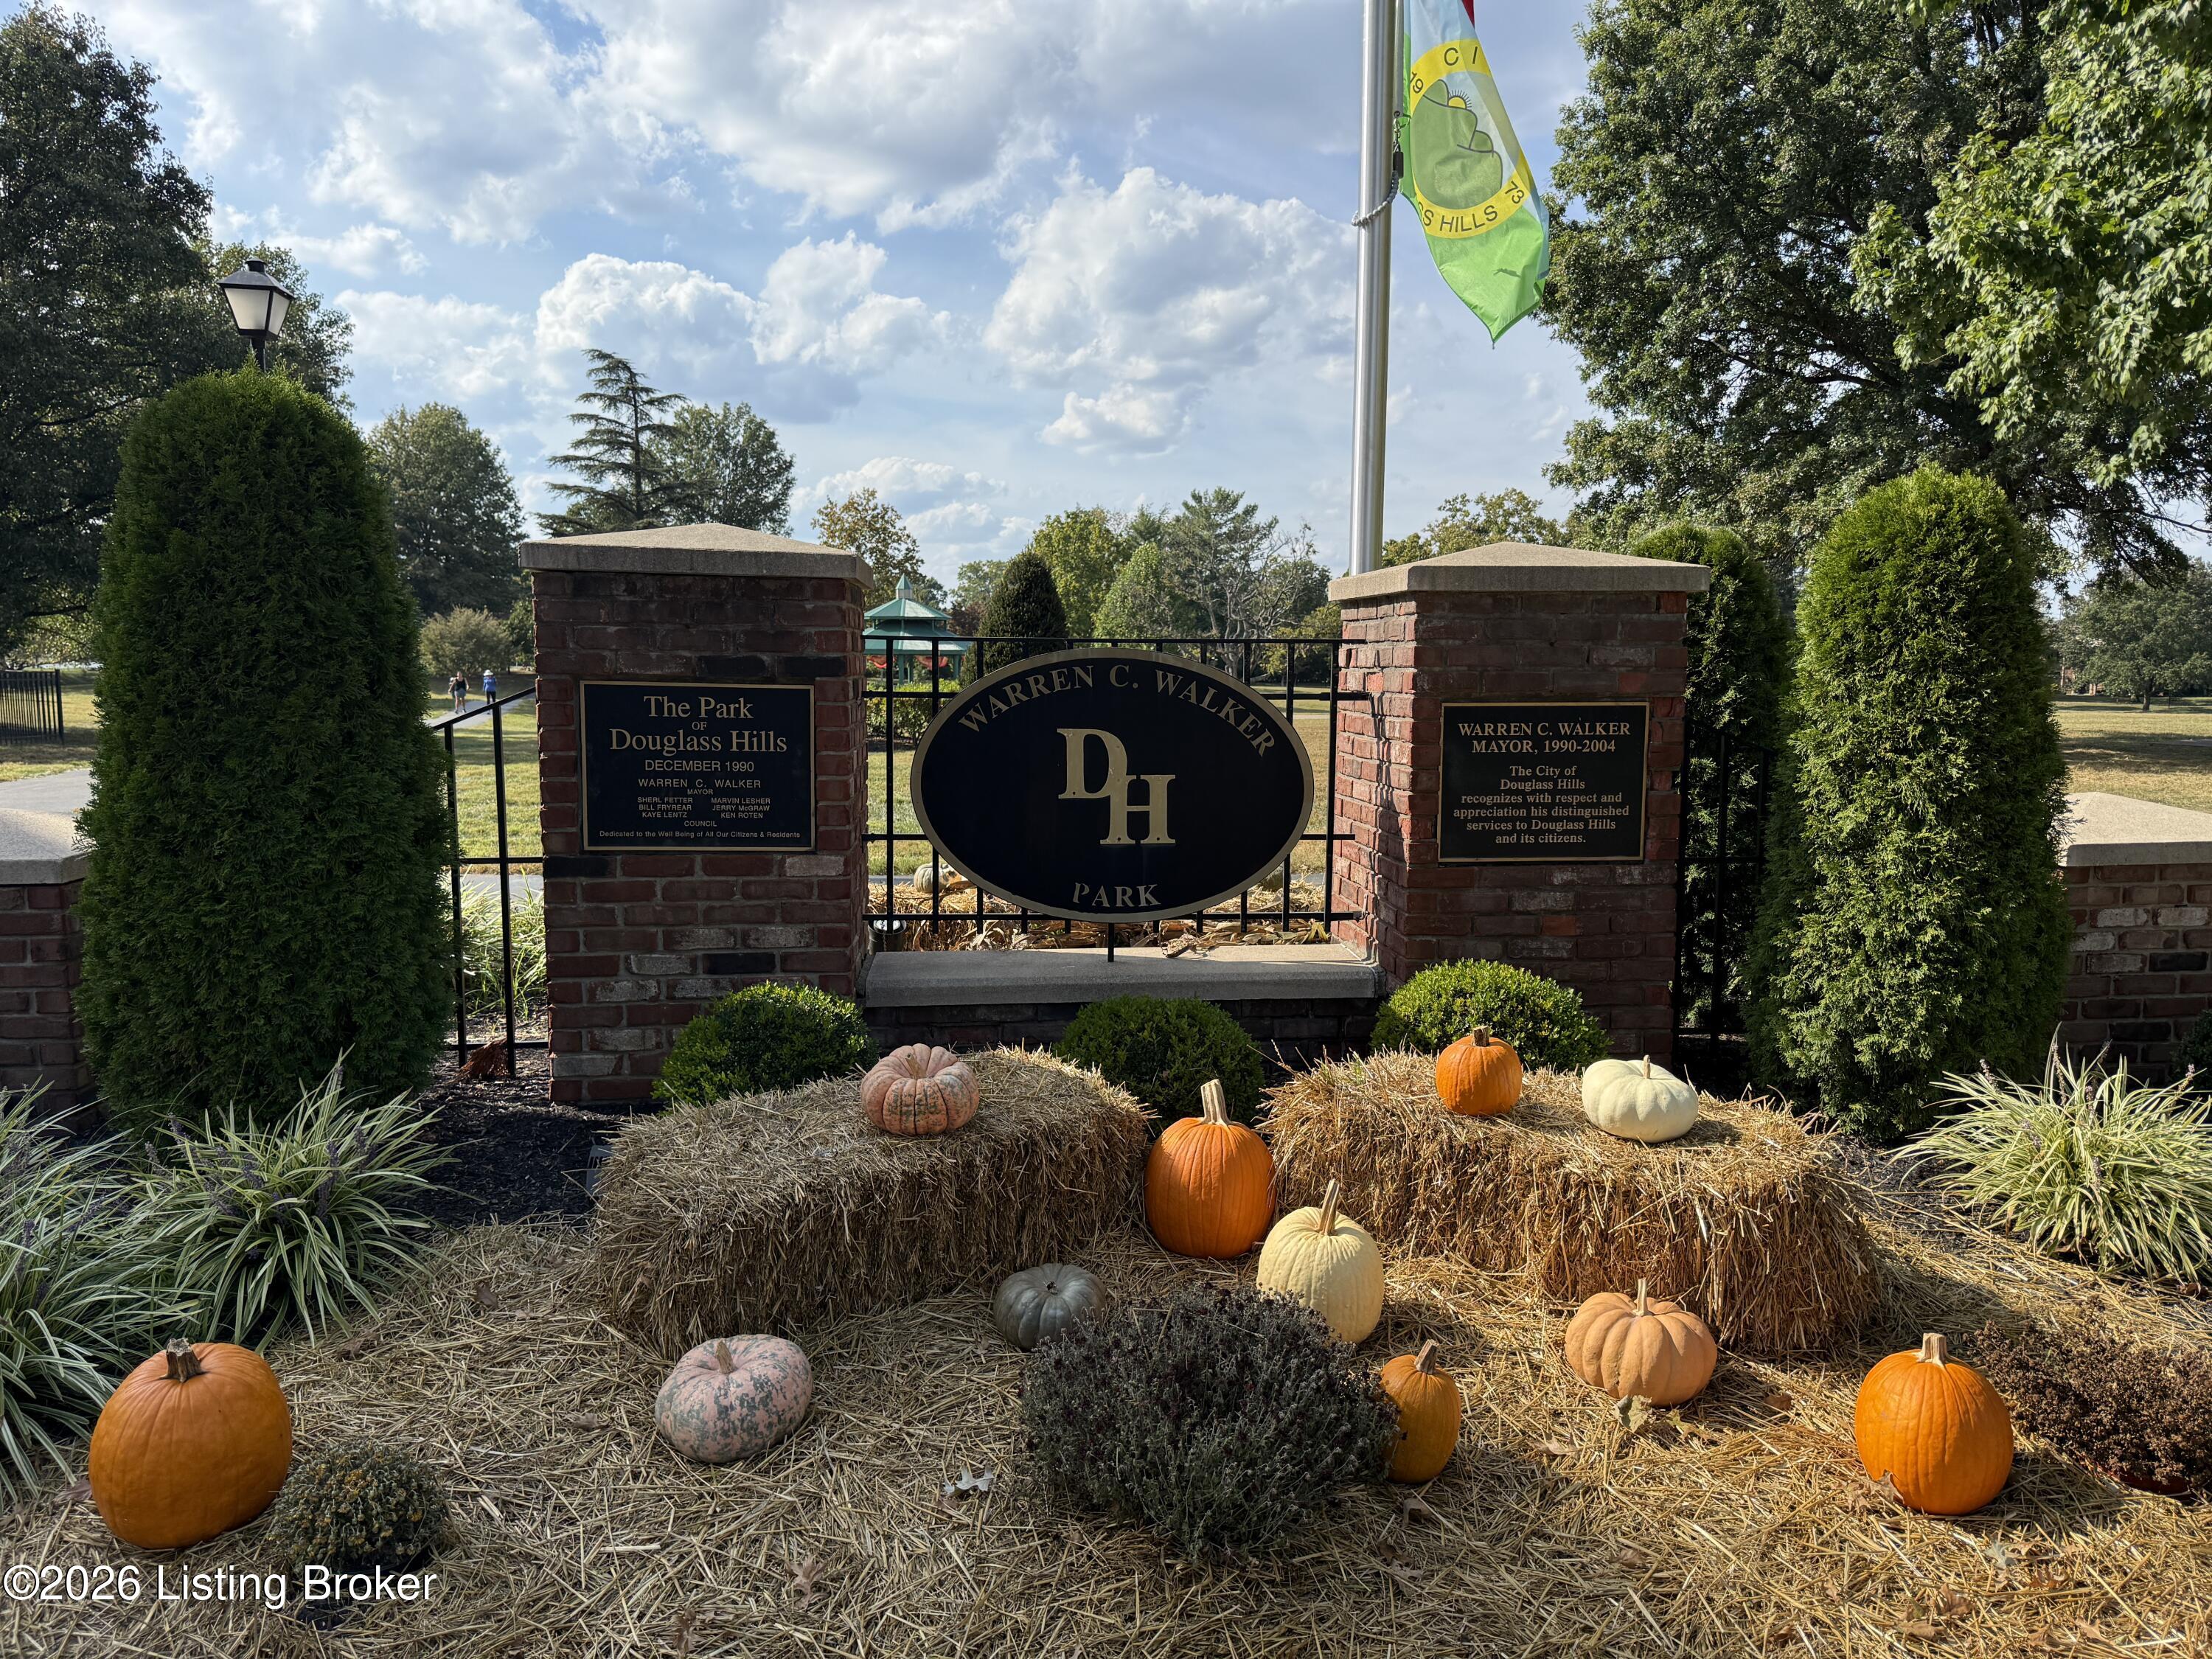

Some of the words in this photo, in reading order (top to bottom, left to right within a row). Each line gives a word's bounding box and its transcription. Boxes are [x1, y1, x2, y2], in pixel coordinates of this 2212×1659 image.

[1505, 181, 1525, 204] 73
[1439, 205, 1498, 232] HILLS
[644, 695, 691, 717] The
[698, 697, 754, 719] Park
[959, 665, 1094, 733] WARREN
[1109, 664, 1139, 689] C.
[1155, 669, 1276, 758] WALKER
[692, 721, 707, 731] OF
[1458, 723, 1532, 736] WARREN
[1537, 723, 1553, 736] C.
[1558, 723, 1630, 735] WALKER
[609, 728, 722, 757] Douglass
[729, 730, 787, 752] Hills
[1472, 740, 1538, 754] MAYOR,
[1543, 740, 1615, 753] 1990-2004
[644, 759, 720, 772] DECEMBER
[725, 761, 754, 772] 1990
[1510, 765, 1532, 776] The
[1536, 765, 1560, 778] City
[1564, 765, 1577, 776] of
[638, 779, 688, 787] WARREN
[695, 779, 706, 787] C.
[714, 779, 761, 788] WALKER
[1500, 779, 1554, 792] Douglass
[1557, 779, 1585, 790] Hills
[1461, 793, 1523, 806] recognizes
[1527, 793, 1551, 803] with
[1556, 794, 1597, 805] respect
[1601, 793, 1622, 803] and
[1453, 807, 1526, 819] appreciation
[1531, 807, 1548, 816] his
[1551, 806, 1630, 818] distinguished
[1467, 821, 1512, 831] services
[1516, 821, 1528, 830] to
[1531, 820, 1585, 832] Douglass
[1587, 819, 1616, 830] Hills
[1495, 833, 1517, 844] and
[1520, 833, 1534, 844] its
[1538, 832, 1586, 844] citizens.
[1072, 882, 1161, 908] PARK
